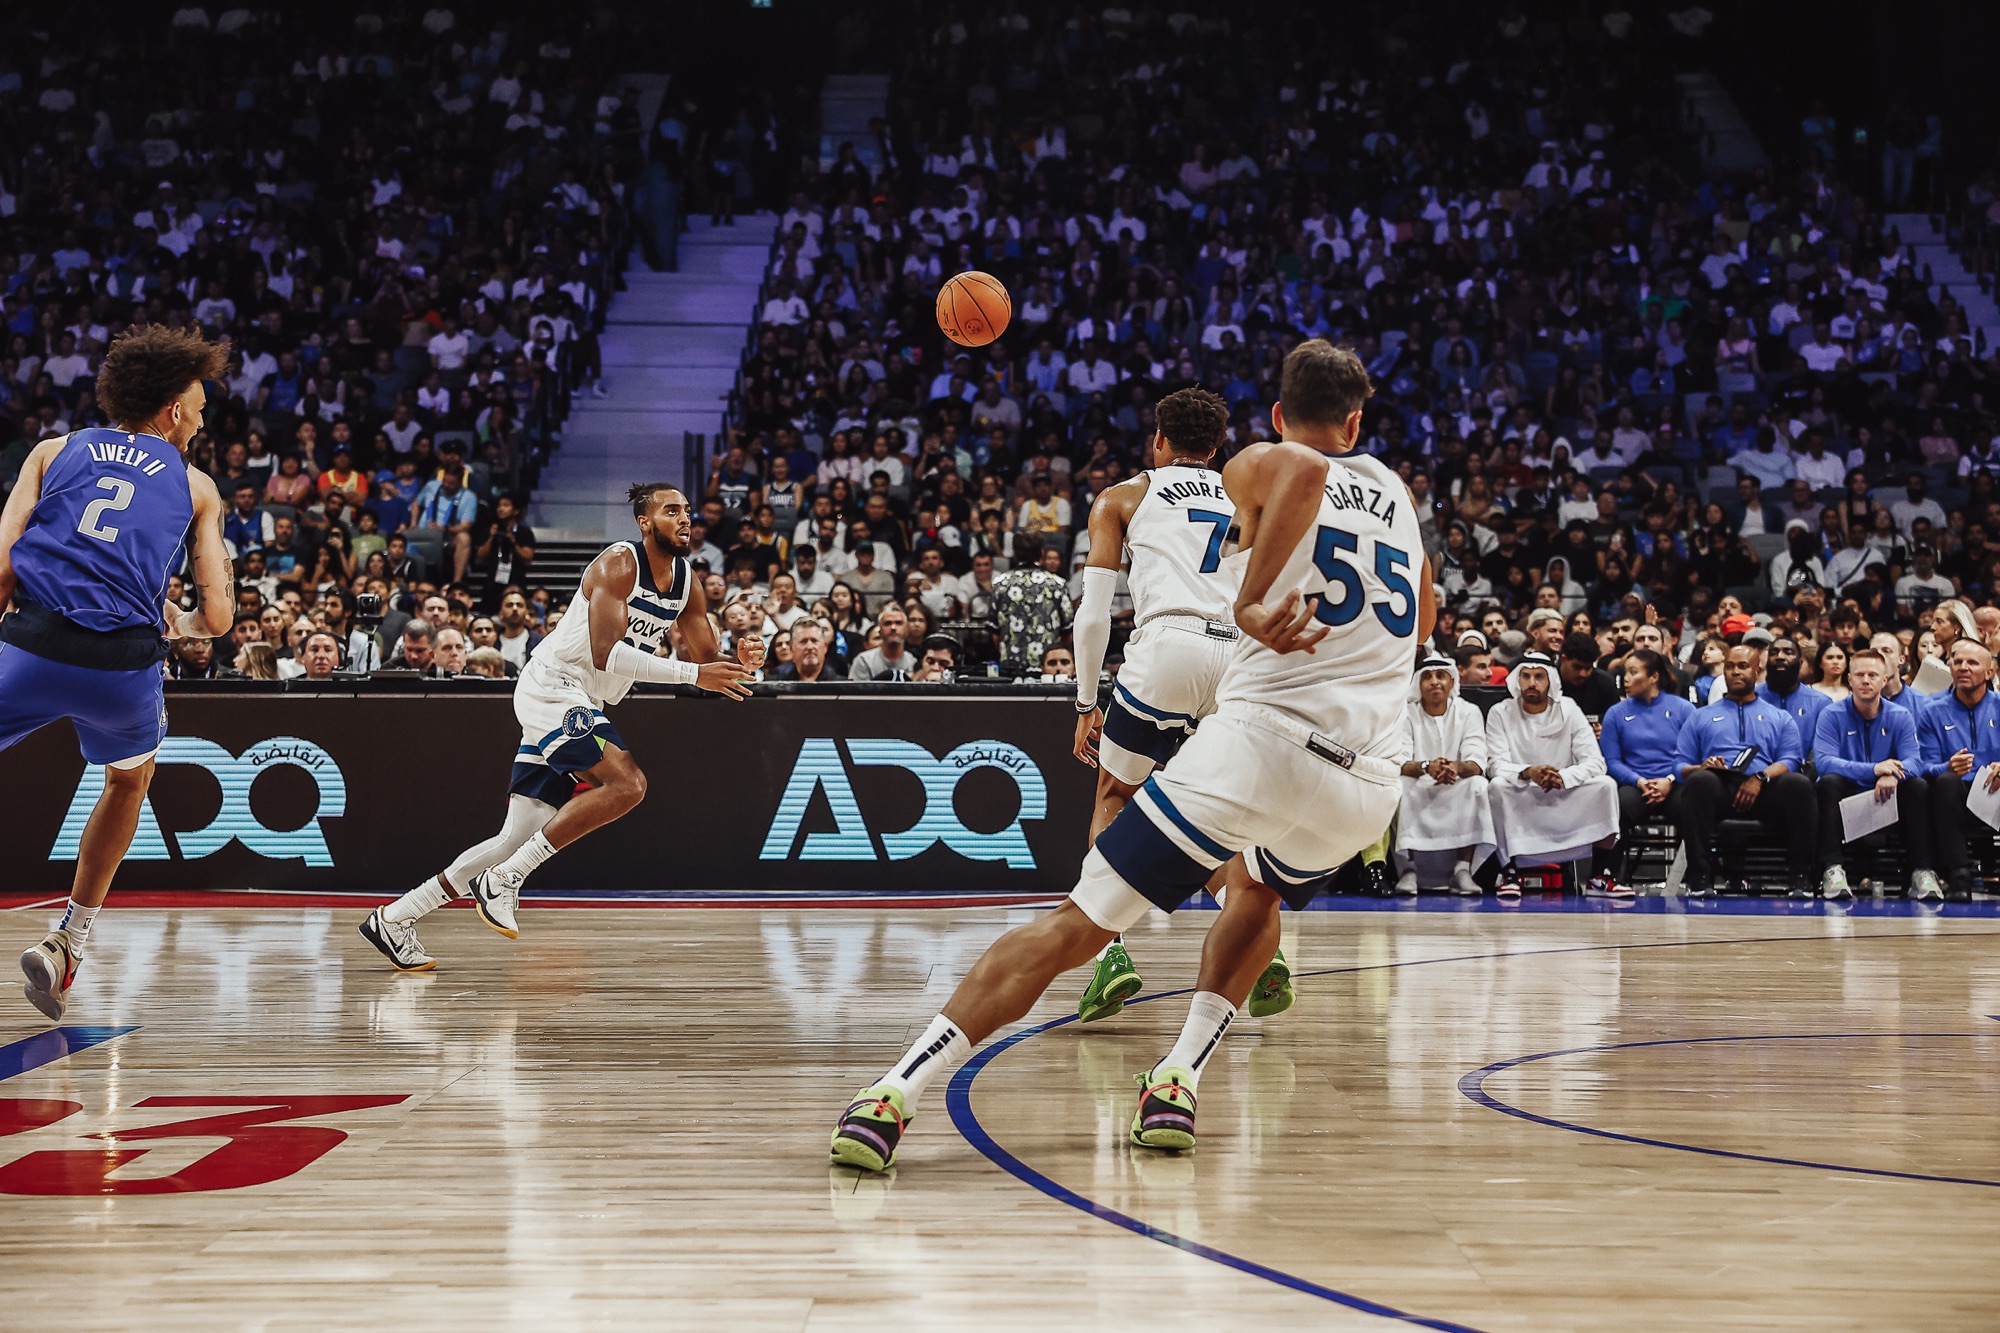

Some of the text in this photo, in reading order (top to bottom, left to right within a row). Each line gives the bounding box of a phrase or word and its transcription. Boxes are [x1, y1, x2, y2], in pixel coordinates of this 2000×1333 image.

[87, 442, 168, 477] LIVELY II
[76, 476, 136, 544] 2
[1157, 480, 1225, 506] MOORE
[1324, 482, 1397, 529] GARZA
[1187, 508, 1232, 574] 7
[1303, 524, 1417, 639] 55
[249, 743, 326, 771] القابضة
[952, 746, 1027, 773] القابضة
[758, 737, 1048, 870] ADQ
